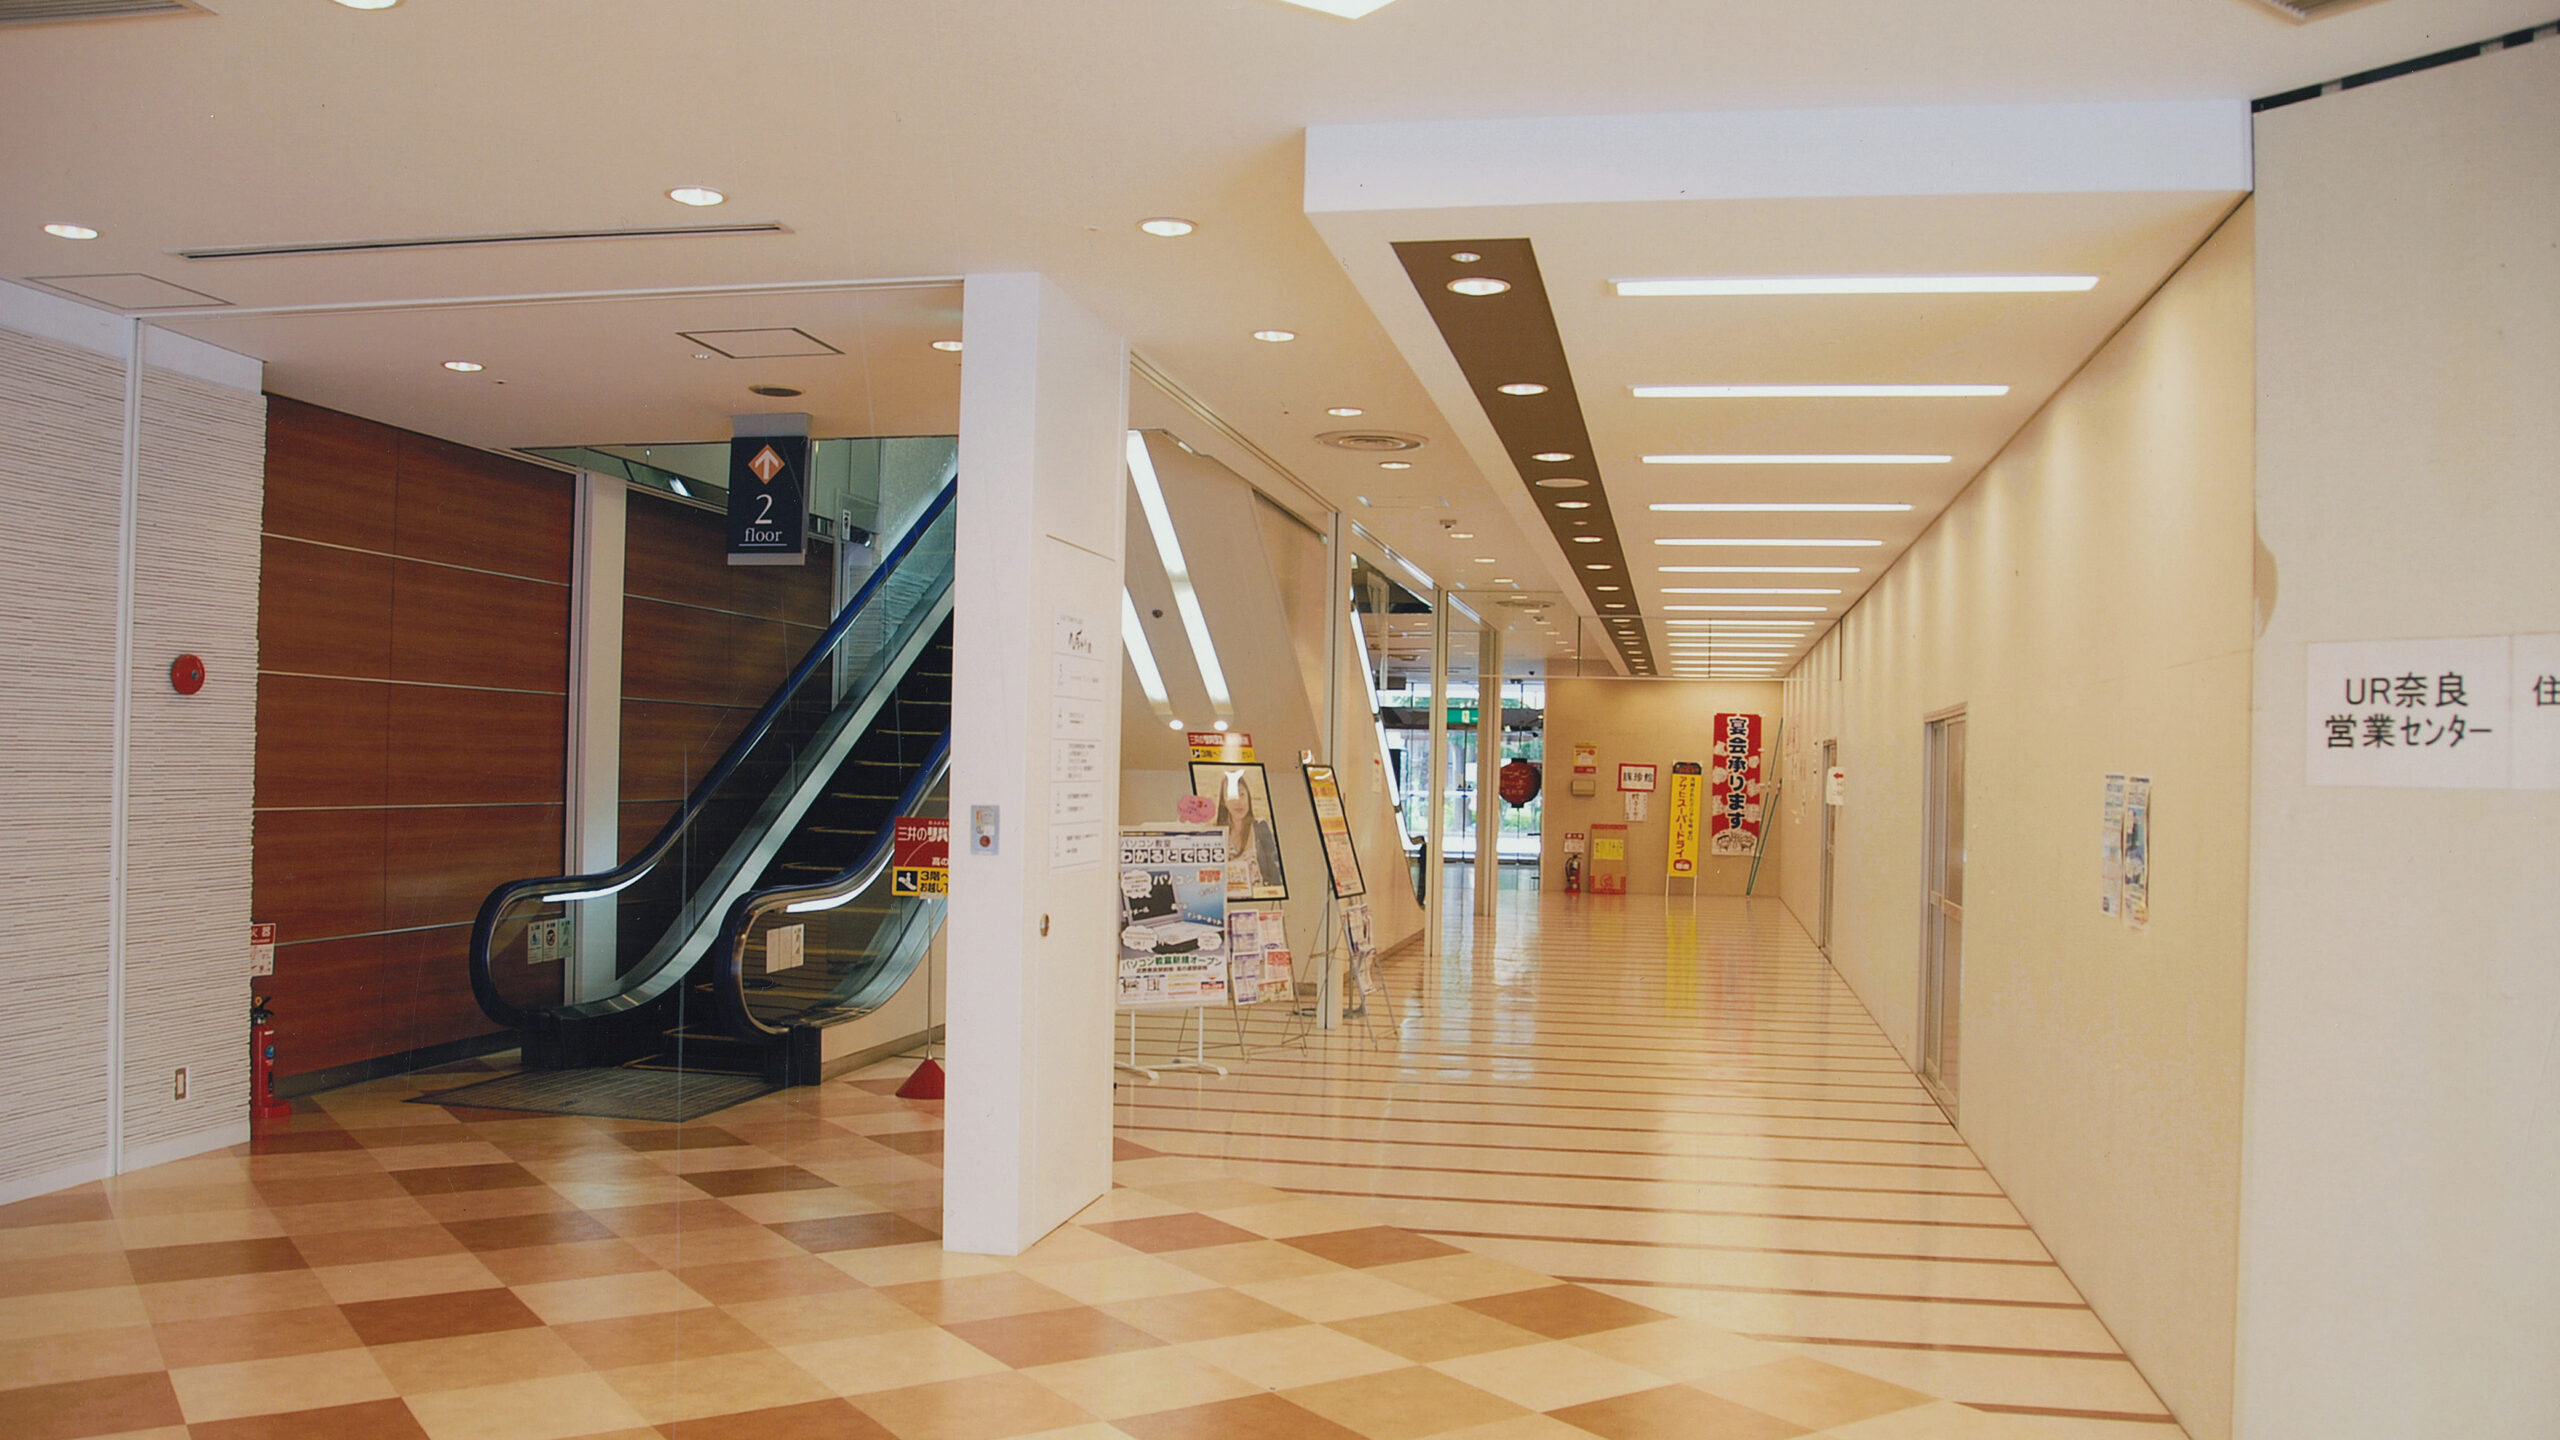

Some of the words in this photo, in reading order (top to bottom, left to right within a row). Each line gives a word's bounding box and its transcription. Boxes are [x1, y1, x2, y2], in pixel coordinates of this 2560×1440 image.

[754, 494, 773, 525] 2
[744, 528, 783, 542] floor
[2345, 671, 2468, 708] UR奈良
[2324, 713, 2493, 748] 営業センター
[1727, 717, 1748, 829] 宴会承ります
[1675, 775, 1688, 859] アサヒスーパードライ
[1119, 849, 1225, 863] わかるとできる
